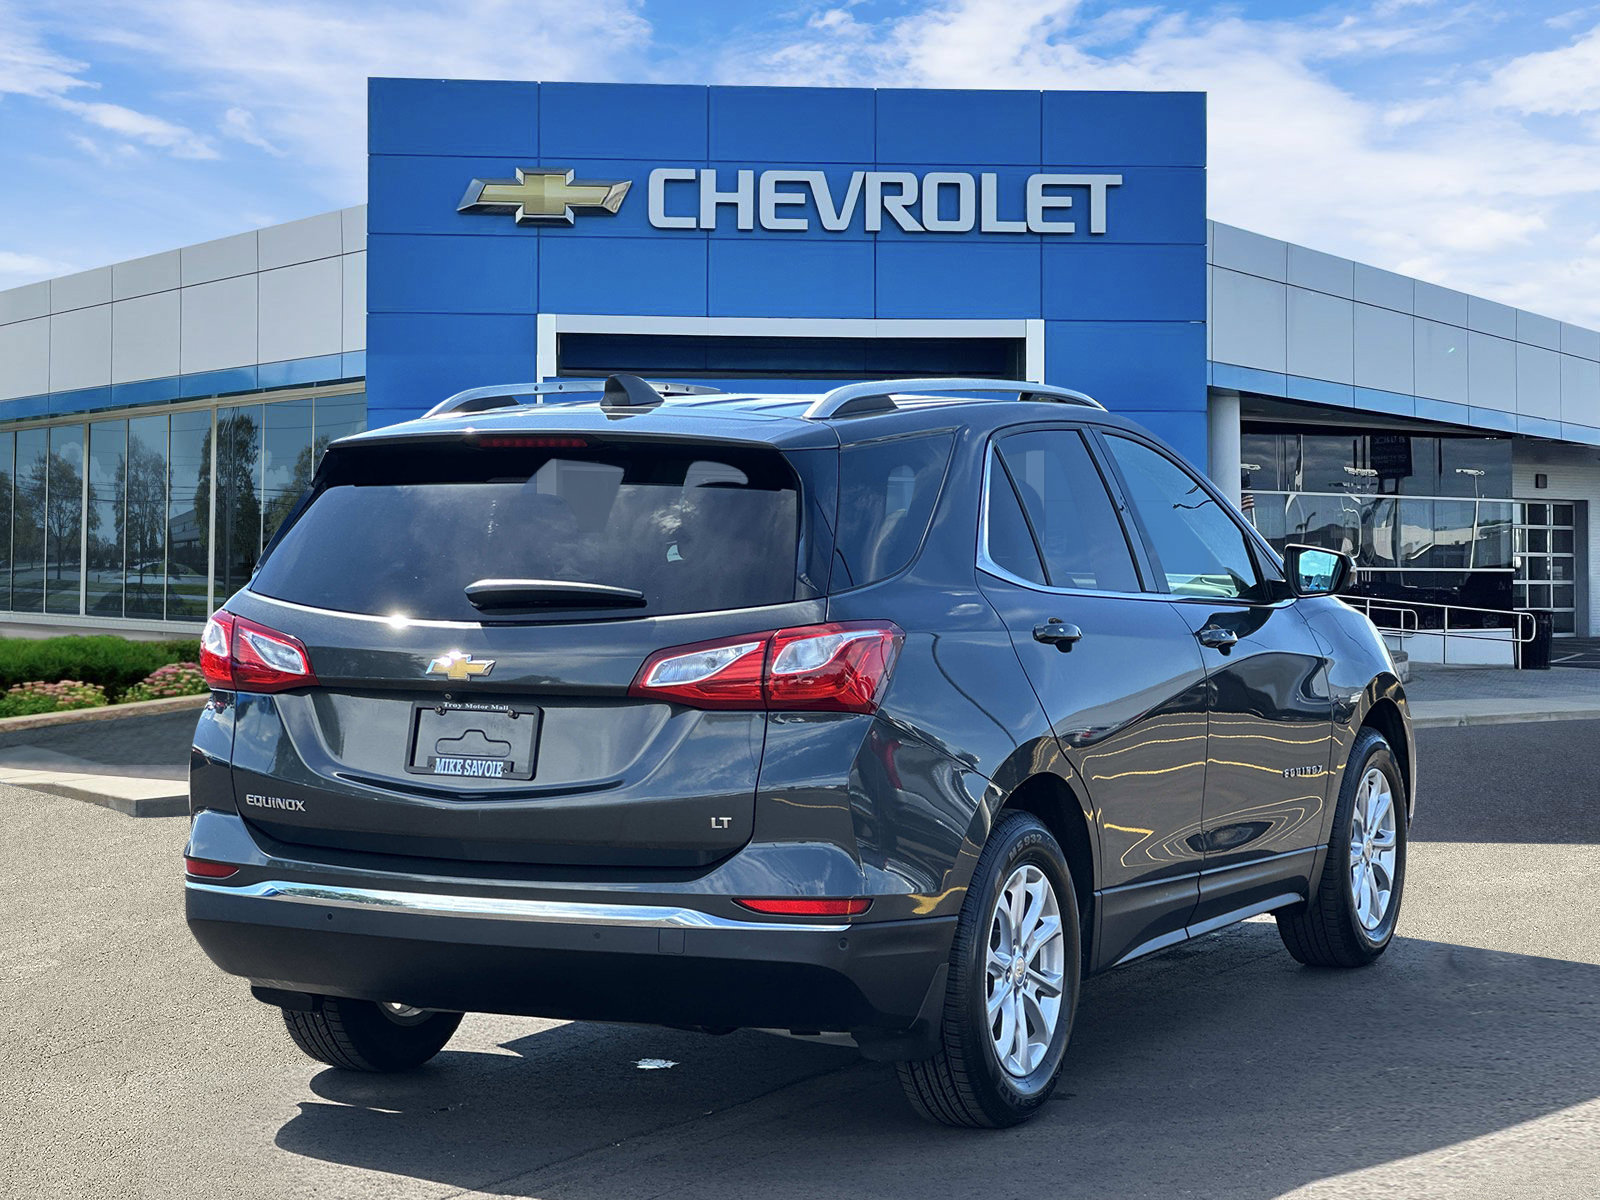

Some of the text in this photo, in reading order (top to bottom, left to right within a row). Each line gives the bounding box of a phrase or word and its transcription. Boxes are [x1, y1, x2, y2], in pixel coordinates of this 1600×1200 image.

[648, 168, 1123, 234] CHEVROLET
[434, 758, 504, 777] MIKE SAVOIE
[246, 794, 306, 812] EQUINOX
[711, 817, 732, 829] LT
